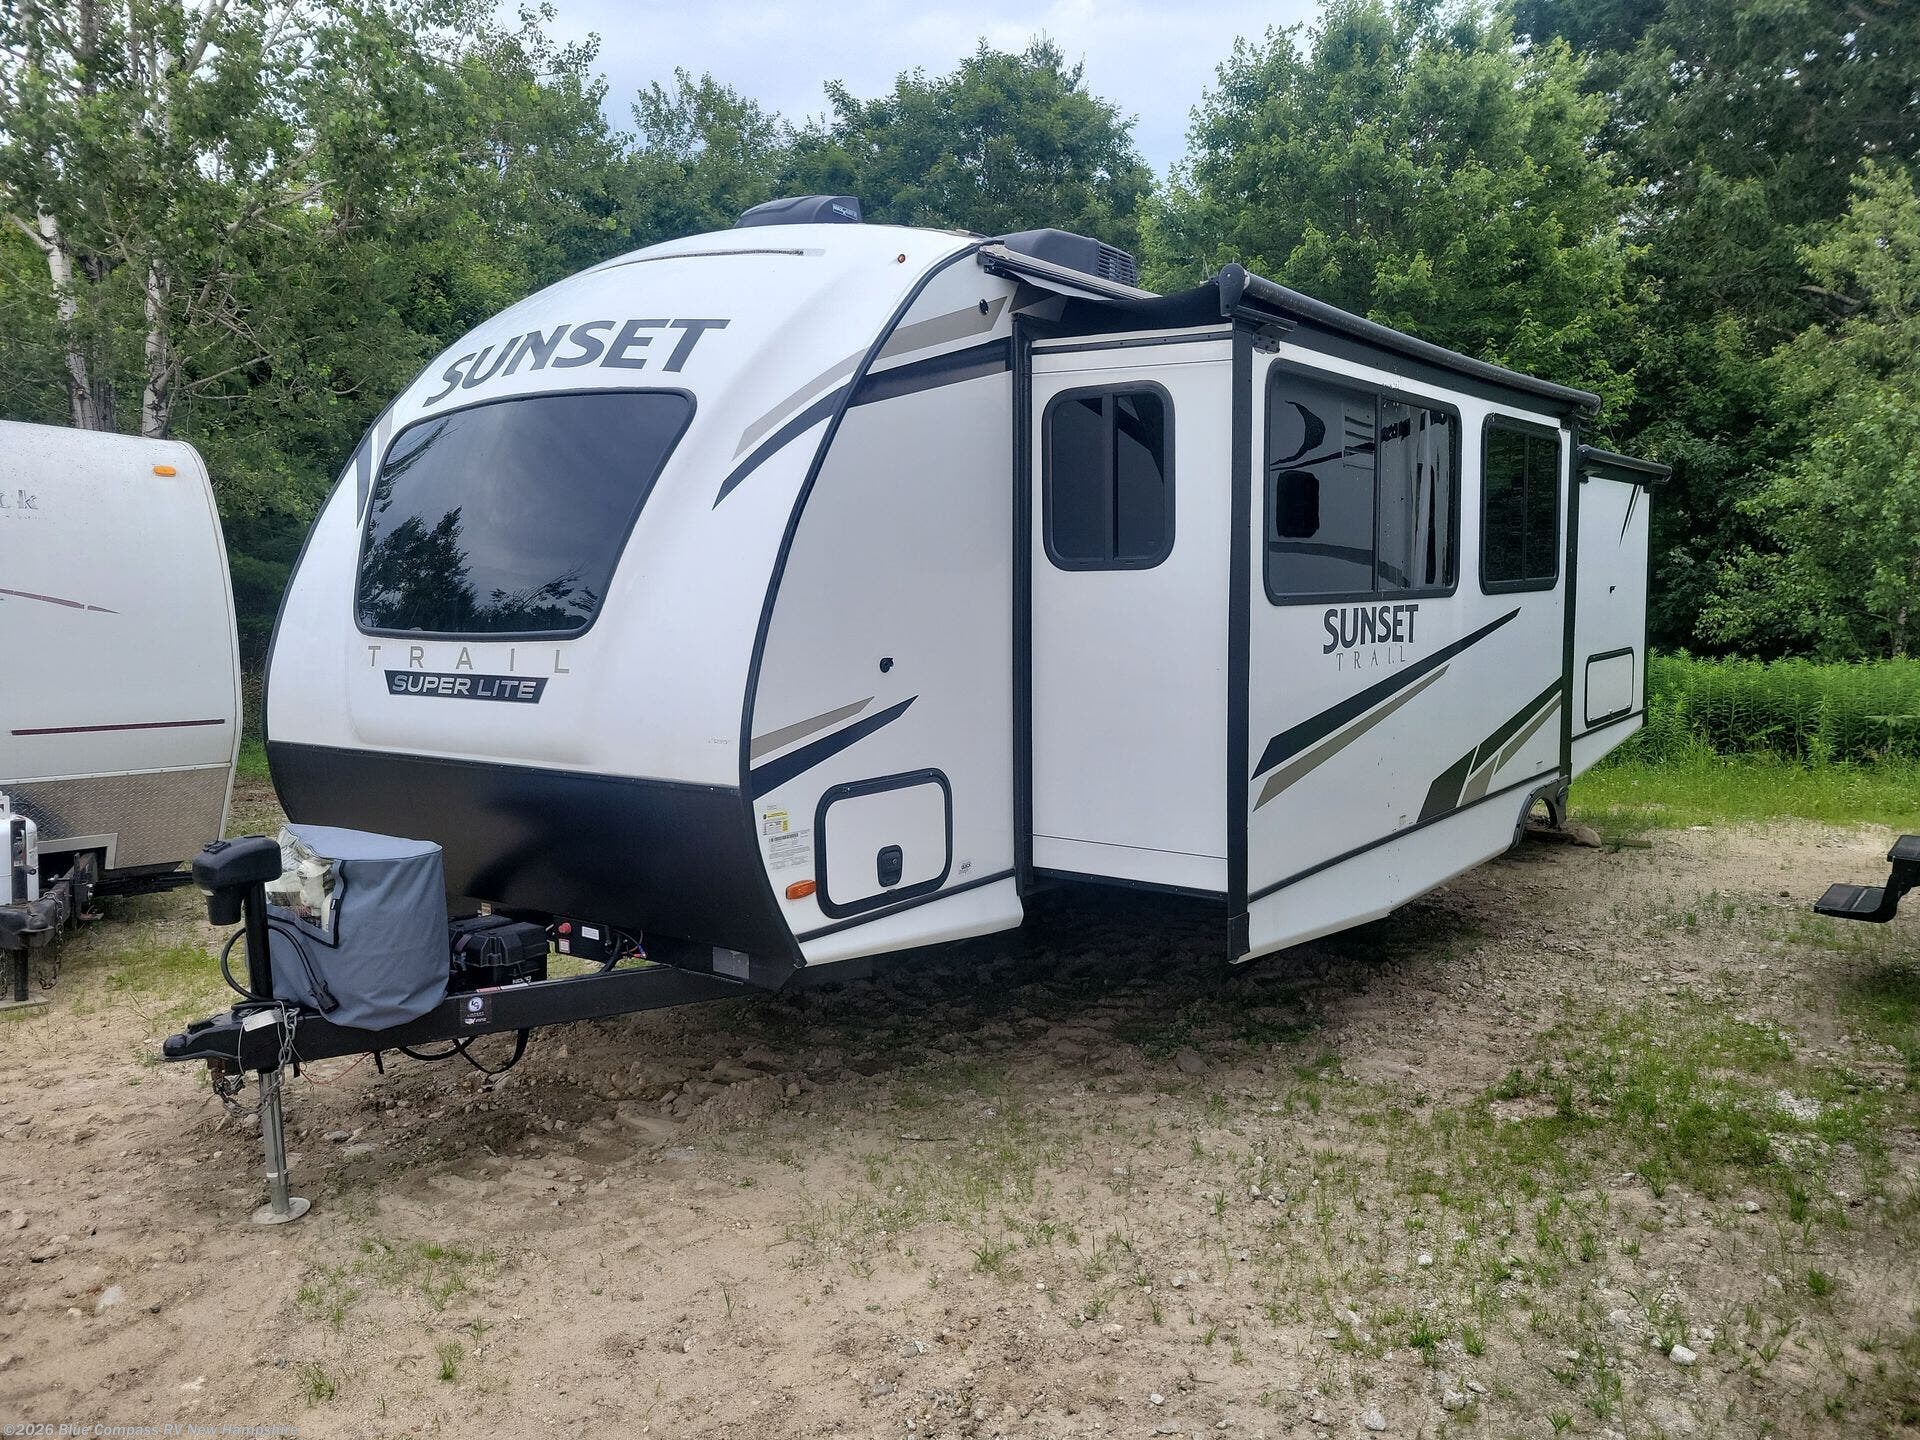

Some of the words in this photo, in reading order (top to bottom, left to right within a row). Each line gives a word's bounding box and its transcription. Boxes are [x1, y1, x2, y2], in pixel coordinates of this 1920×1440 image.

[423, 318, 731, 408] SUNSET
[1323, 604, 1418, 655] SUNSET
[368, 645, 570, 674] TRAIL
[1336, 646, 1406, 671] TRAIL
[392, 673, 472, 695] SUPER
[477, 679, 539, 700] LITE
